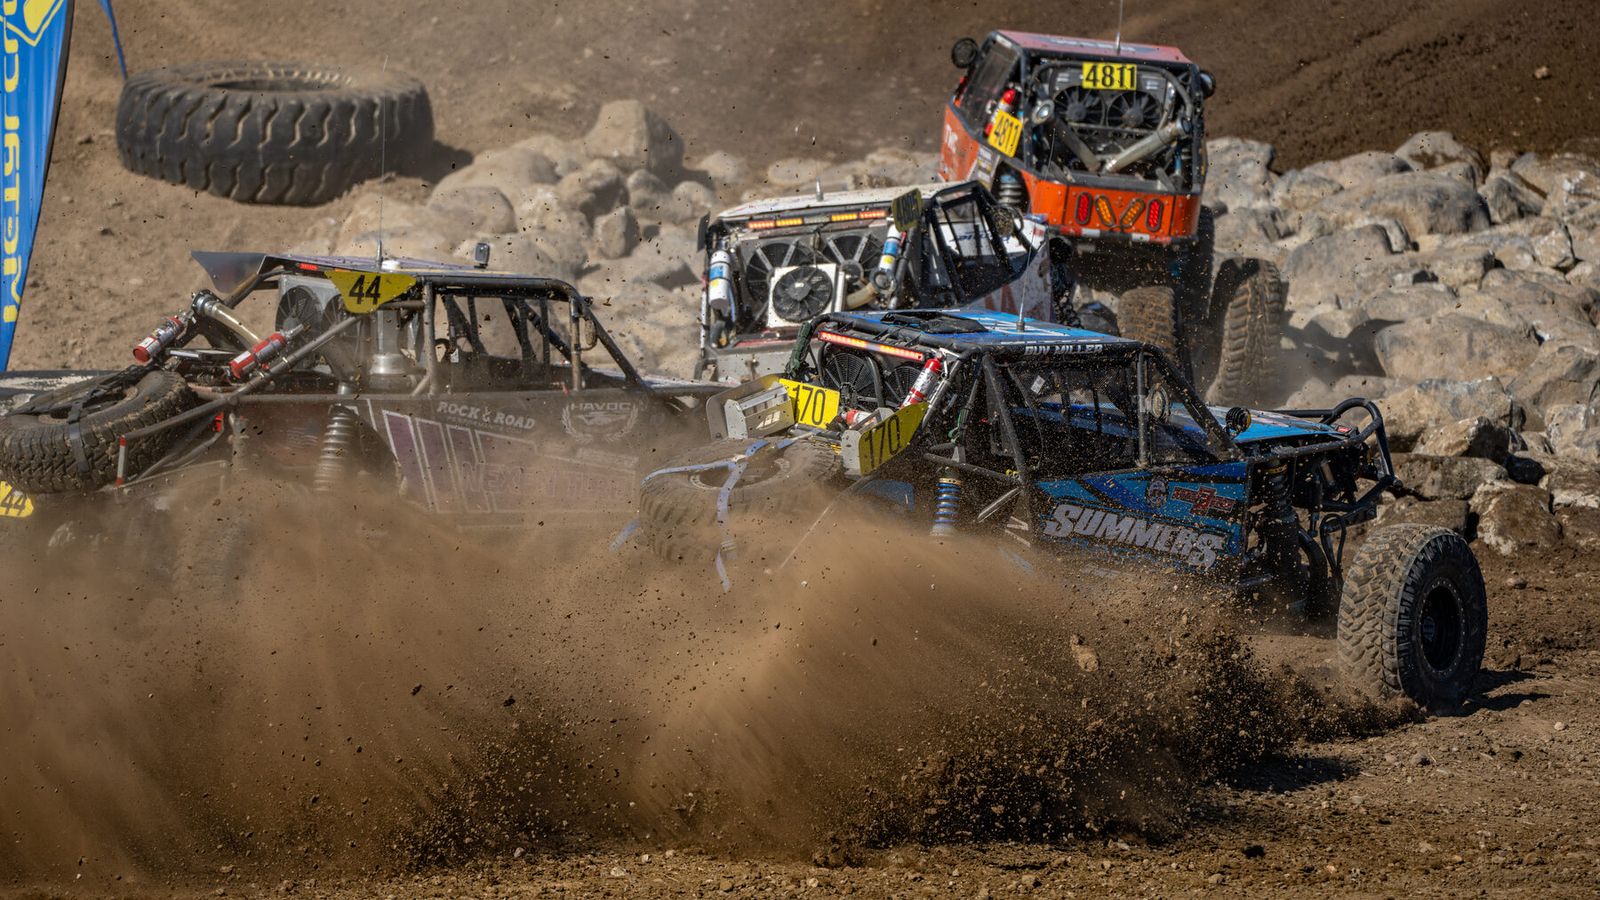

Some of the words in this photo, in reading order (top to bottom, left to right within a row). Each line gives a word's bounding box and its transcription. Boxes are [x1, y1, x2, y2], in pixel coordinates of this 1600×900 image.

[1085, 64, 1136, 89] 4811
[993, 115, 1020, 154] 4811
[348, 274, 381, 305] 44
[1054, 344, 1103, 355] MILLER
[436, 401, 481, 420] ROCK
[494, 411, 536, 430] ROAD
[570, 402, 632, 411] HAVOC
[791, 384, 827, 426] 170
[864, 415, 902, 470] 170
[0, 488, 27, 516] 44
[1043, 504, 1226, 568] SUMMERS
